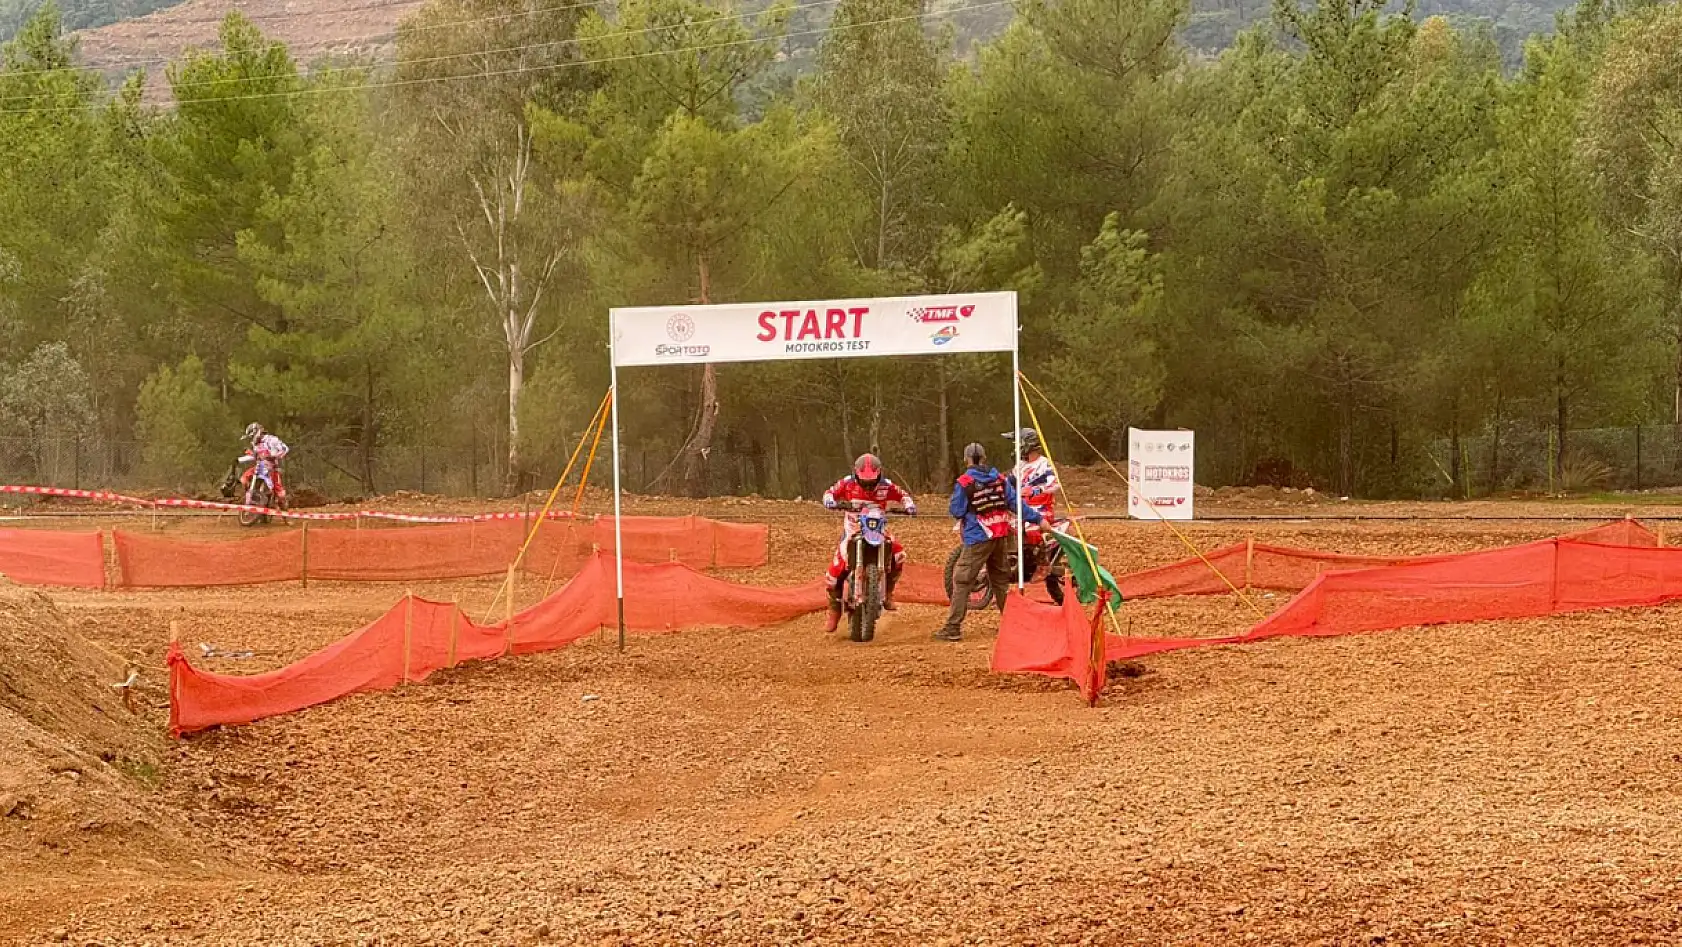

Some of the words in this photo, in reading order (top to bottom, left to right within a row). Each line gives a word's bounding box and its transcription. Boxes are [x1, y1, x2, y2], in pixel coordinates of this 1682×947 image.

[928, 308, 954, 319] TMF
[757, 307, 869, 342] START
[785, 341, 844, 353] MOTOKROS
[846, 340, 871, 351] TEST
